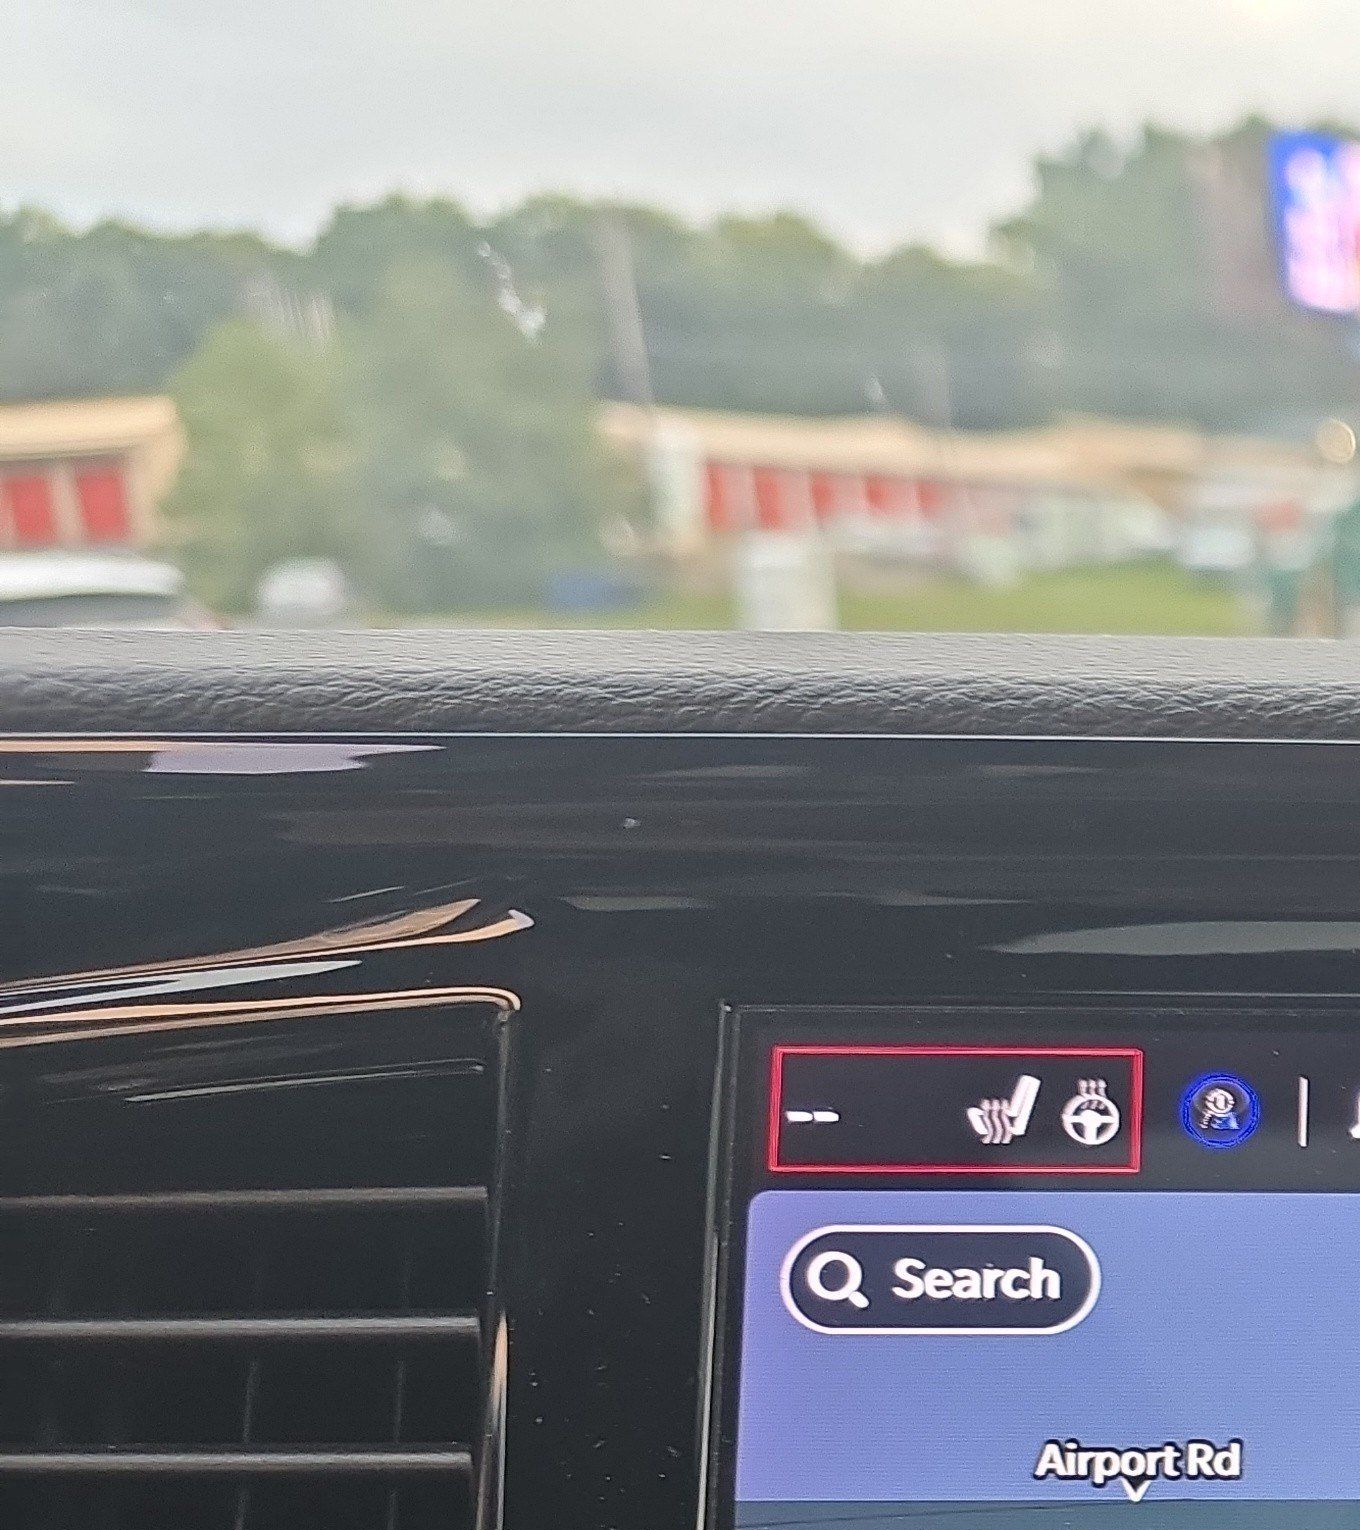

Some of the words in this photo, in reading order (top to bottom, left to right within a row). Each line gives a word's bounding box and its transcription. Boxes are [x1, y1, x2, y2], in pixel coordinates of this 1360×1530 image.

[892, 1258, 1061, 1302] Search
[1035, 1441, 1179, 1486] Airport
[1186, 1440, 1241, 1477] Rd
